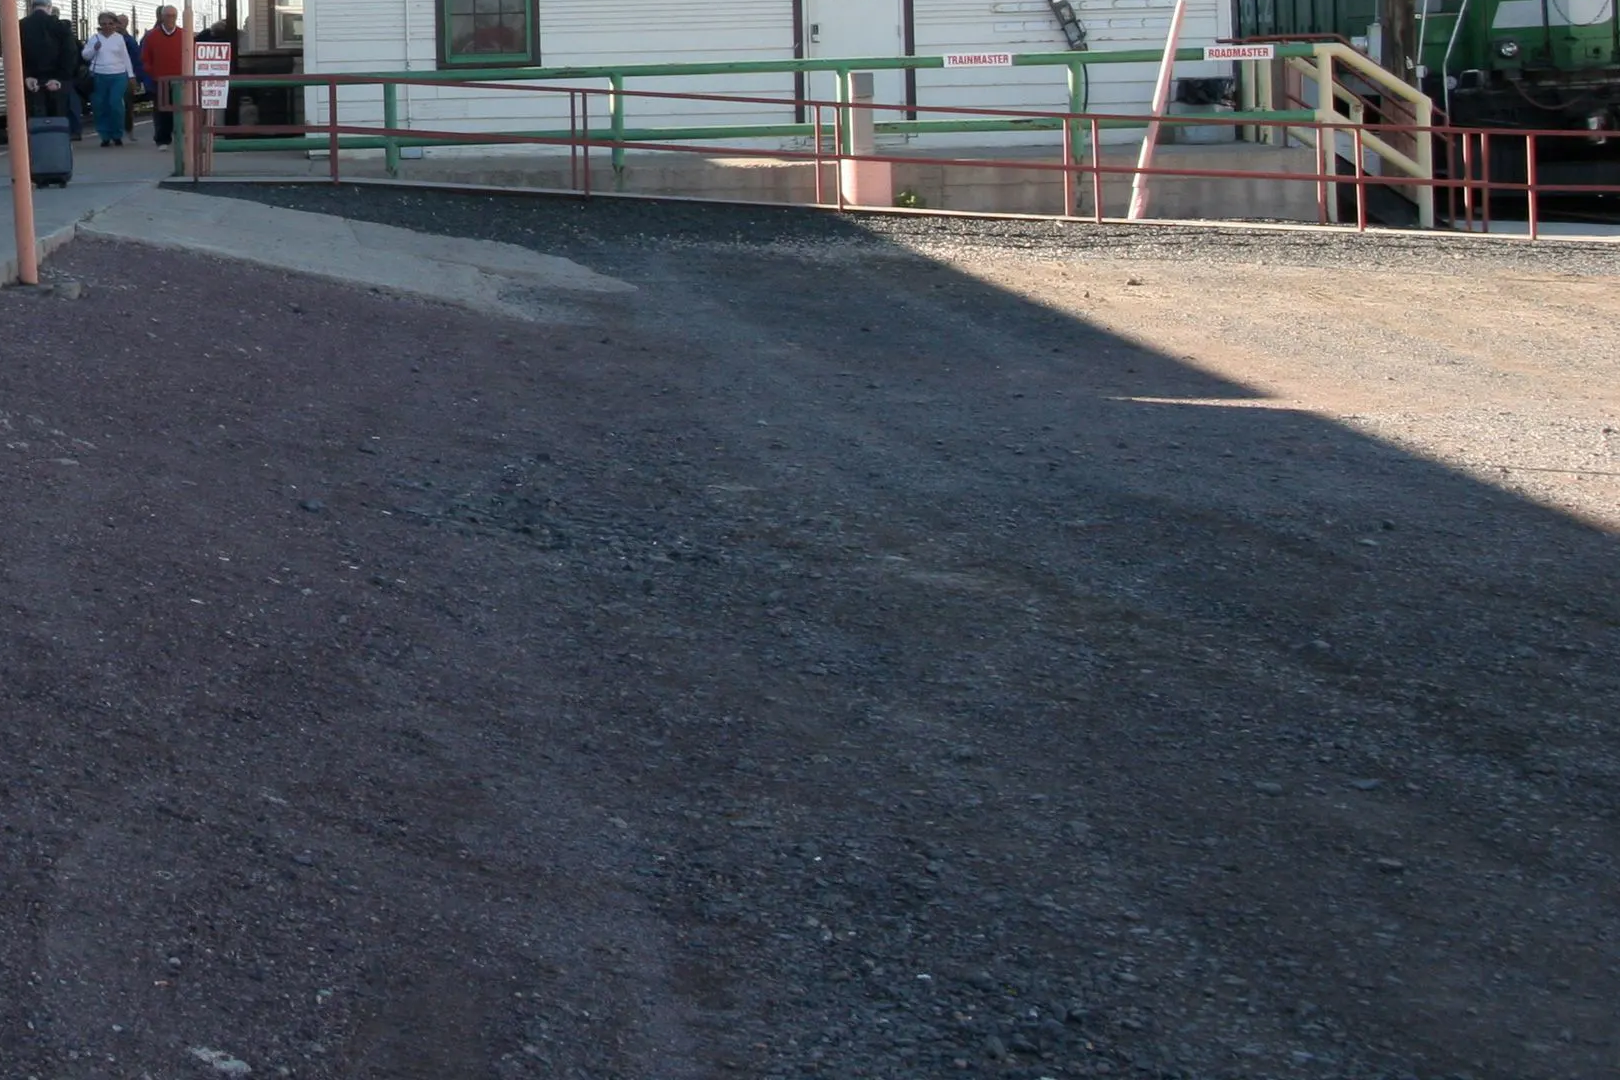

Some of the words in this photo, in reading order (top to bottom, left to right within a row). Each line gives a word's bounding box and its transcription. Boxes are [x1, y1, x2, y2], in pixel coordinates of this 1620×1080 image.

[197, 46, 229, 59] ONLY
[1208, 47, 1269, 58] ROADMASTER
[947, 54, 1009, 65] TRAINMASTER
